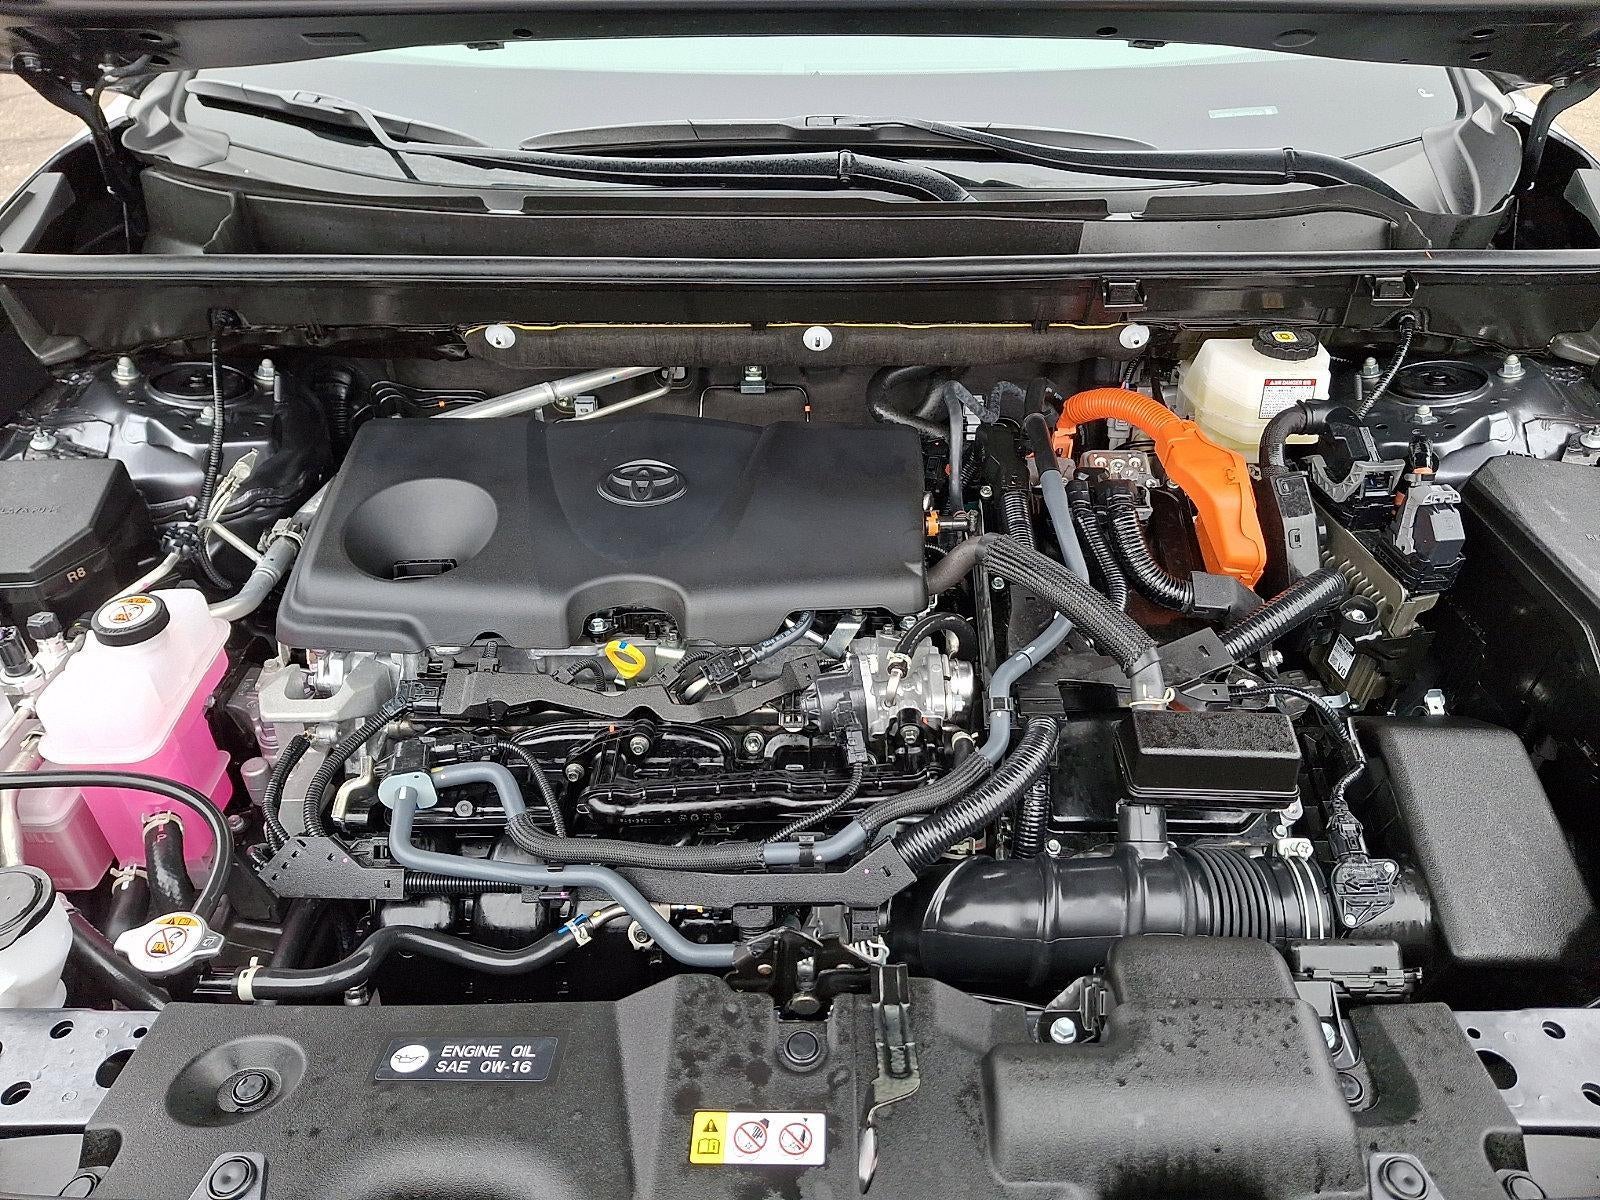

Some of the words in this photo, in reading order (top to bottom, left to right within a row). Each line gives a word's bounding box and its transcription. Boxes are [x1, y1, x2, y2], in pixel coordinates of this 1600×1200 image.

[66, 567, 86, 583] R8
[440, 1045, 502, 1058] ENGINE
[510, 1045, 536, 1058] OIL
[434, 1060, 471, 1074] SAE
[479, 1060, 532, 1074] 0W-16
